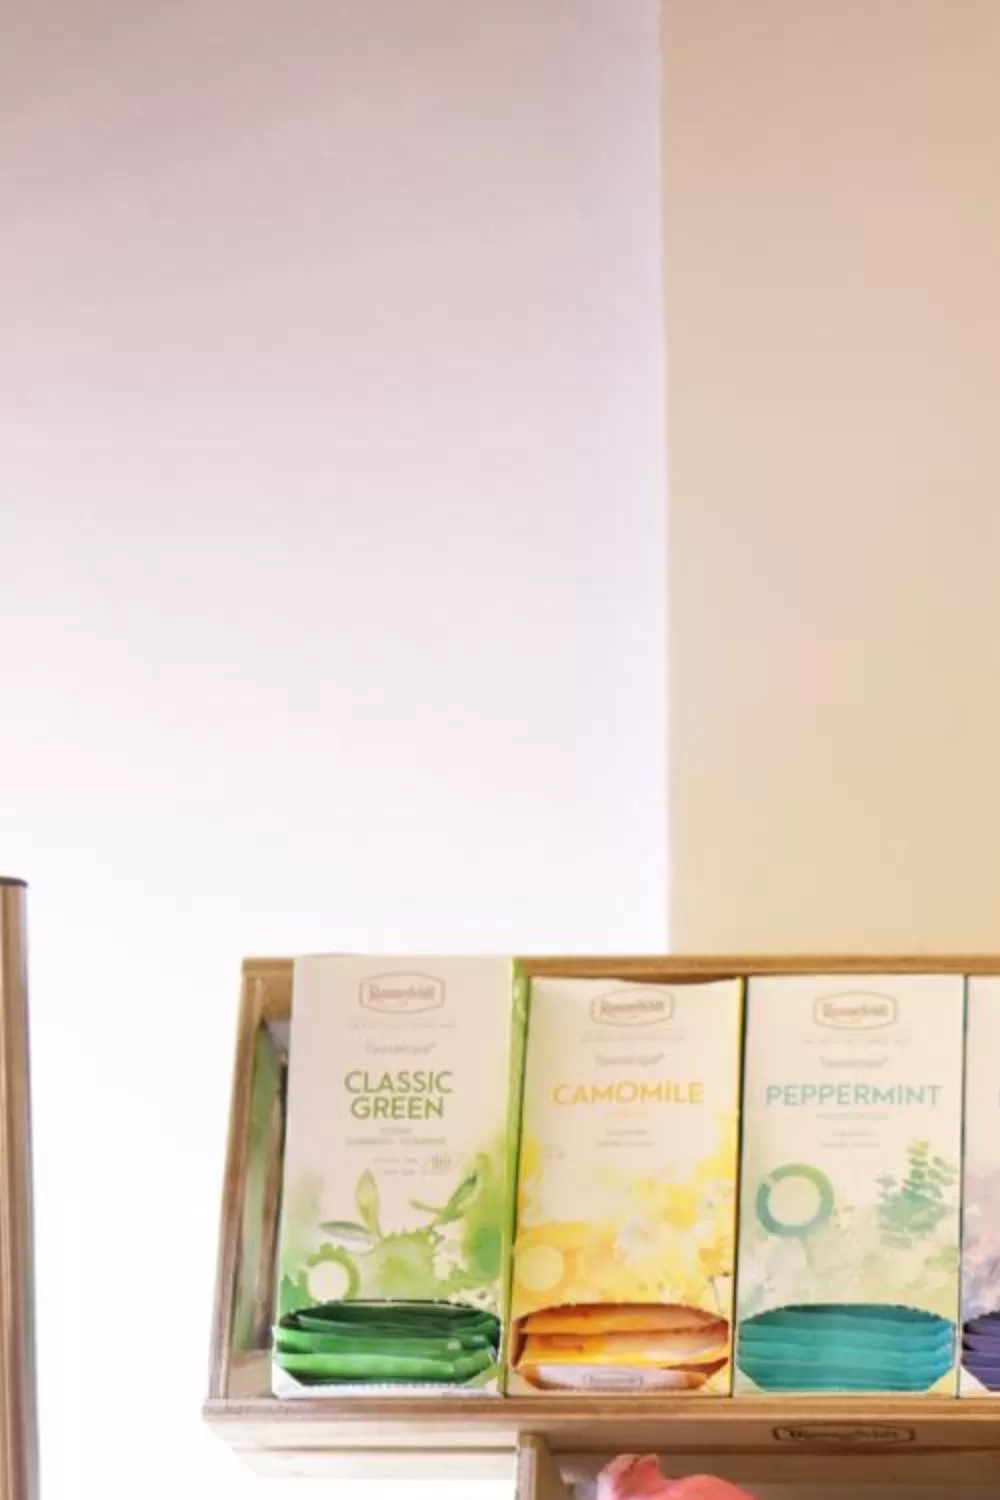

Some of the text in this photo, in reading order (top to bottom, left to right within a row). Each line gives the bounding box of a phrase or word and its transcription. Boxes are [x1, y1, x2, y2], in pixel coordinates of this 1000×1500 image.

[344, 1069, 454, 1095] CLASSIC
[551, 1080, 705, 1107] CAMOMILE
[350, 1095, 445, 1120] GREEN
[765, 1083, 943, 1108] PEPPERMINT
